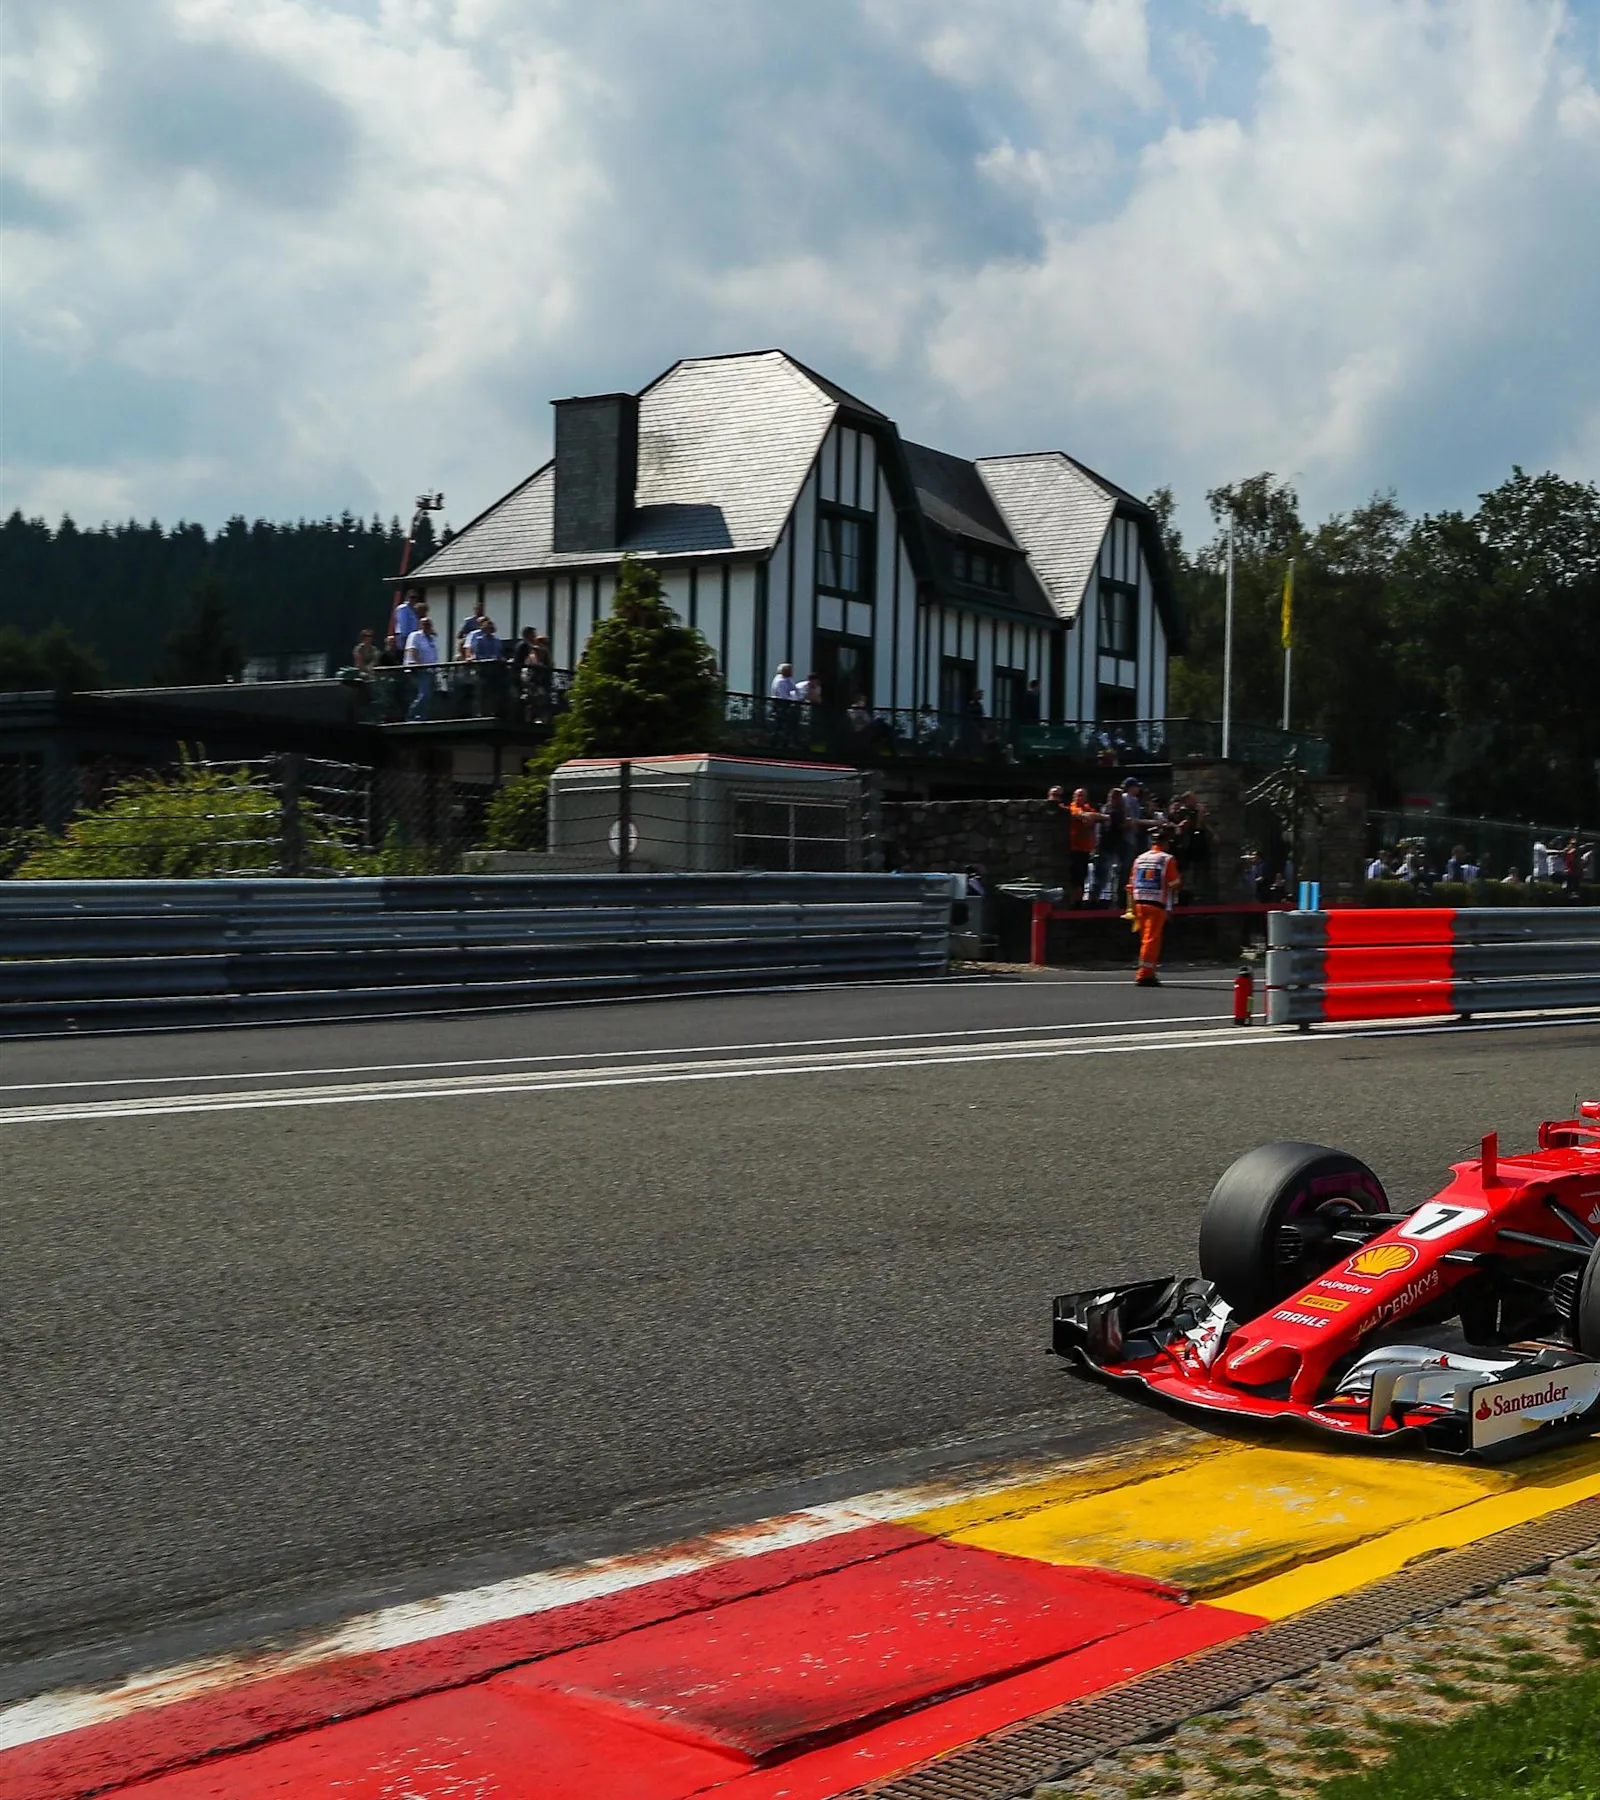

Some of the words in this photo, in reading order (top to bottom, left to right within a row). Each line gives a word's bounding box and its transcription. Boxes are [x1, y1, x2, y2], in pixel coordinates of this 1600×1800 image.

[1412, 1209, 1465, 1235] 7
[1304, 1298, 1342, 1309] PIRELLI
[1272, 1310, 1330, 1328] MAHLE
[1493, 1382, 1568, 1416] Santander
